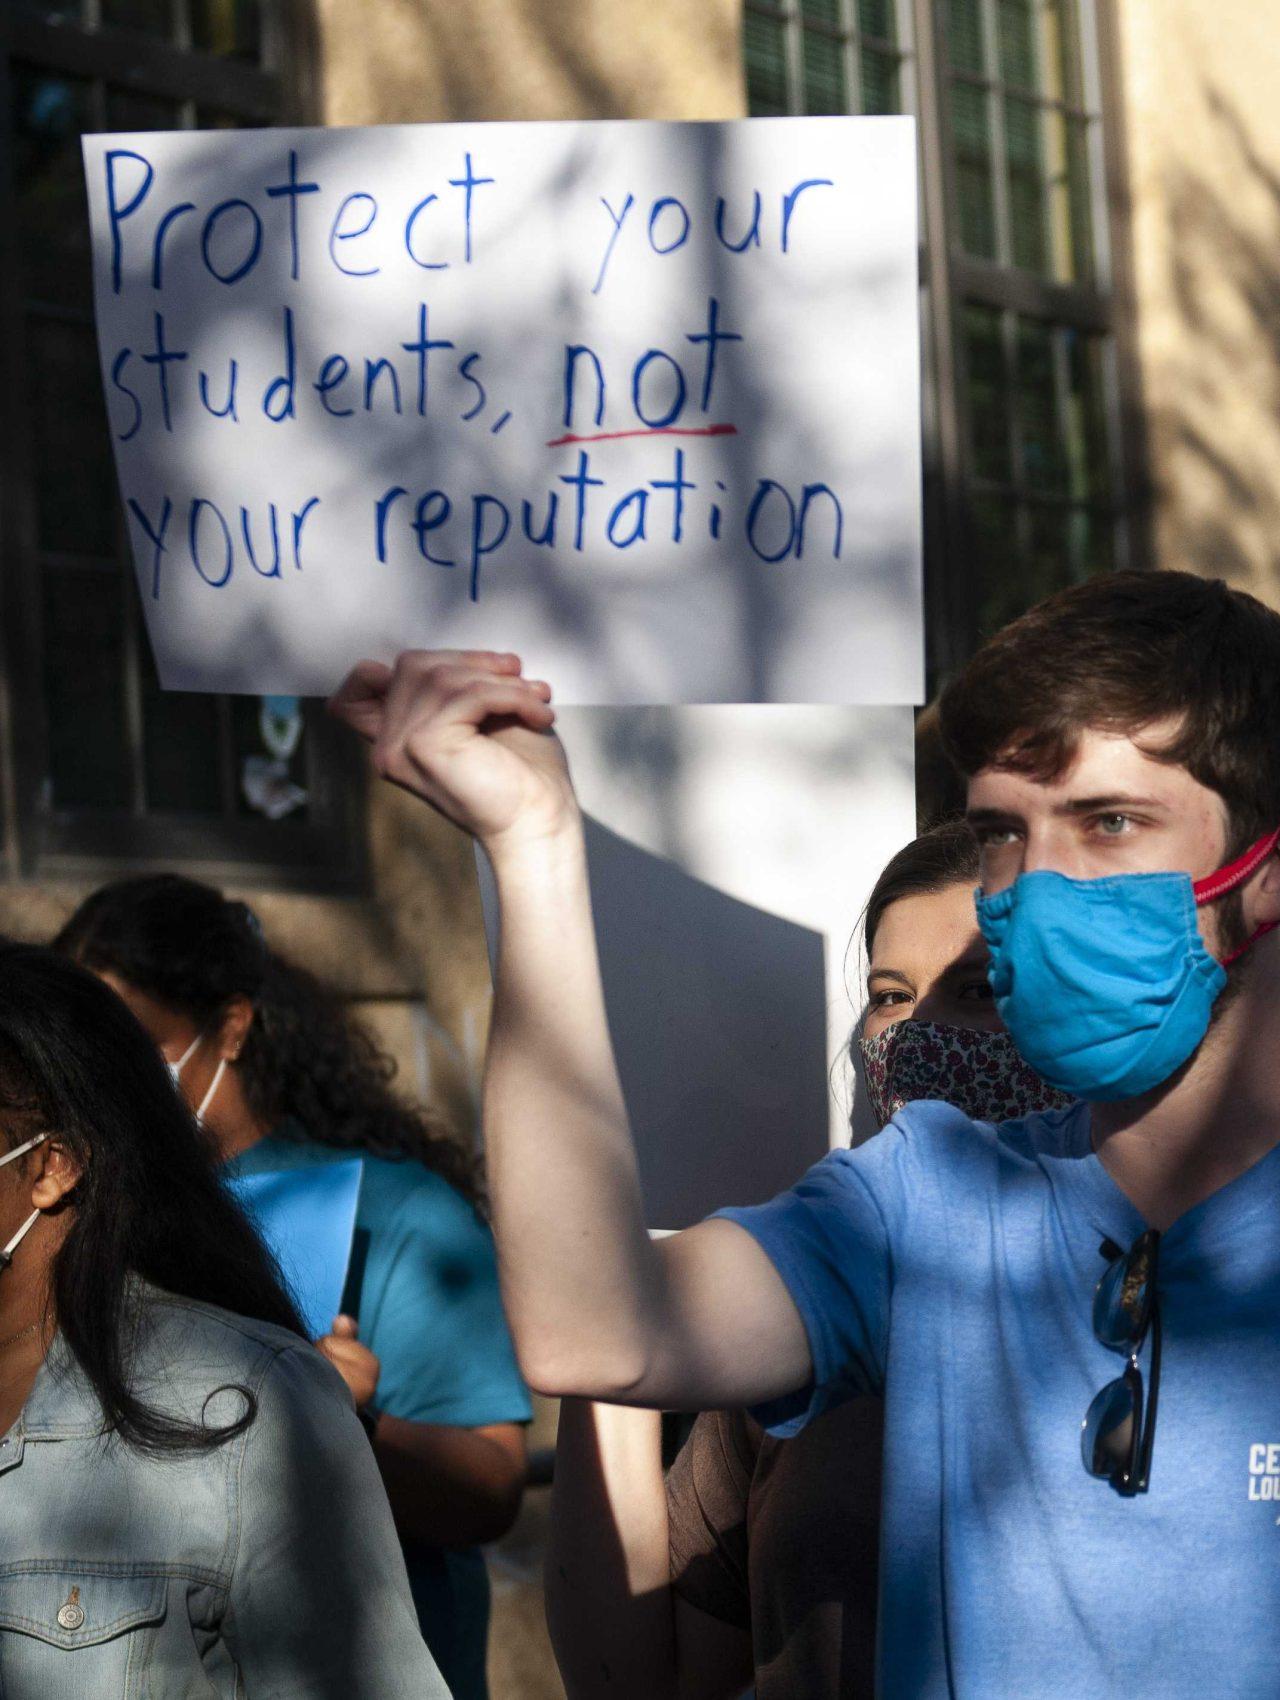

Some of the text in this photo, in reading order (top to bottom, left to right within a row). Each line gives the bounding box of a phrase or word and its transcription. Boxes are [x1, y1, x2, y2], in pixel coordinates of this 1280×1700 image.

[105, 149, 833, 294] Protect your
[111, 298, 742, 441] students, not
[127, 448, 844, 602] your reputation
